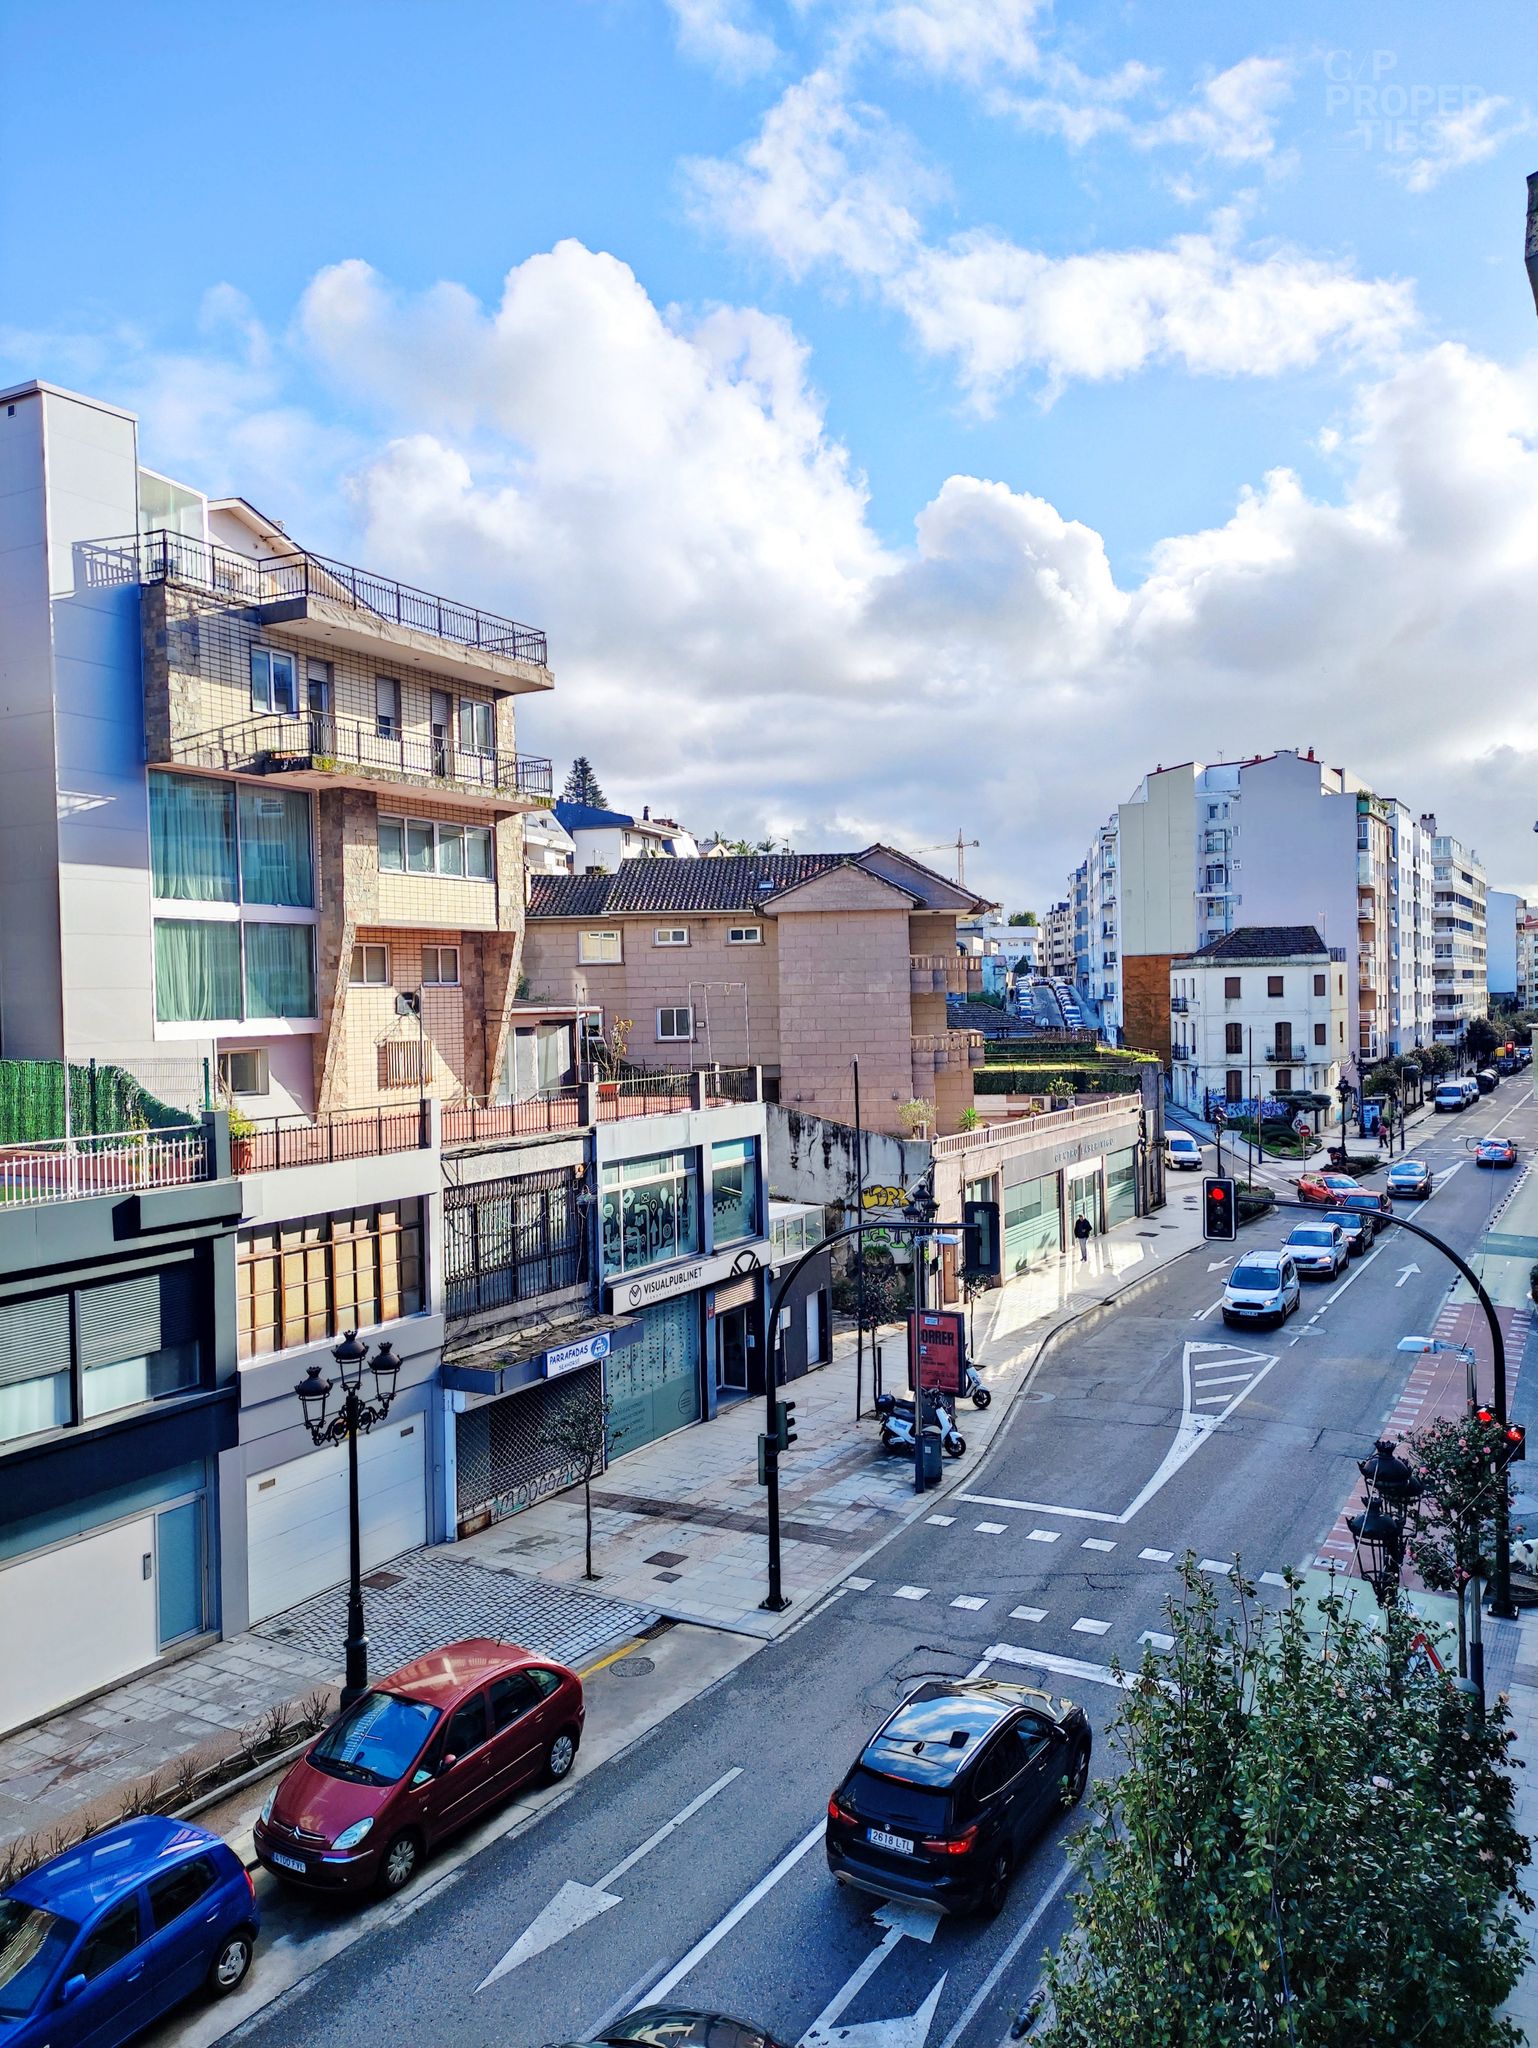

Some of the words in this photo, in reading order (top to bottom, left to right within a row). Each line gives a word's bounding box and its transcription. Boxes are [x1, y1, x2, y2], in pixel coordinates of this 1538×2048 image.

[643, 1267, 703, 1294] VISUALPUBLINET
[920, 1329, 954, 1346] ORRER
[549, 1345, 589, 1365] PARRAFADAS
[873, 1831, 893, 1845] 2618
[896, 1838, 911, 1851] LTL
